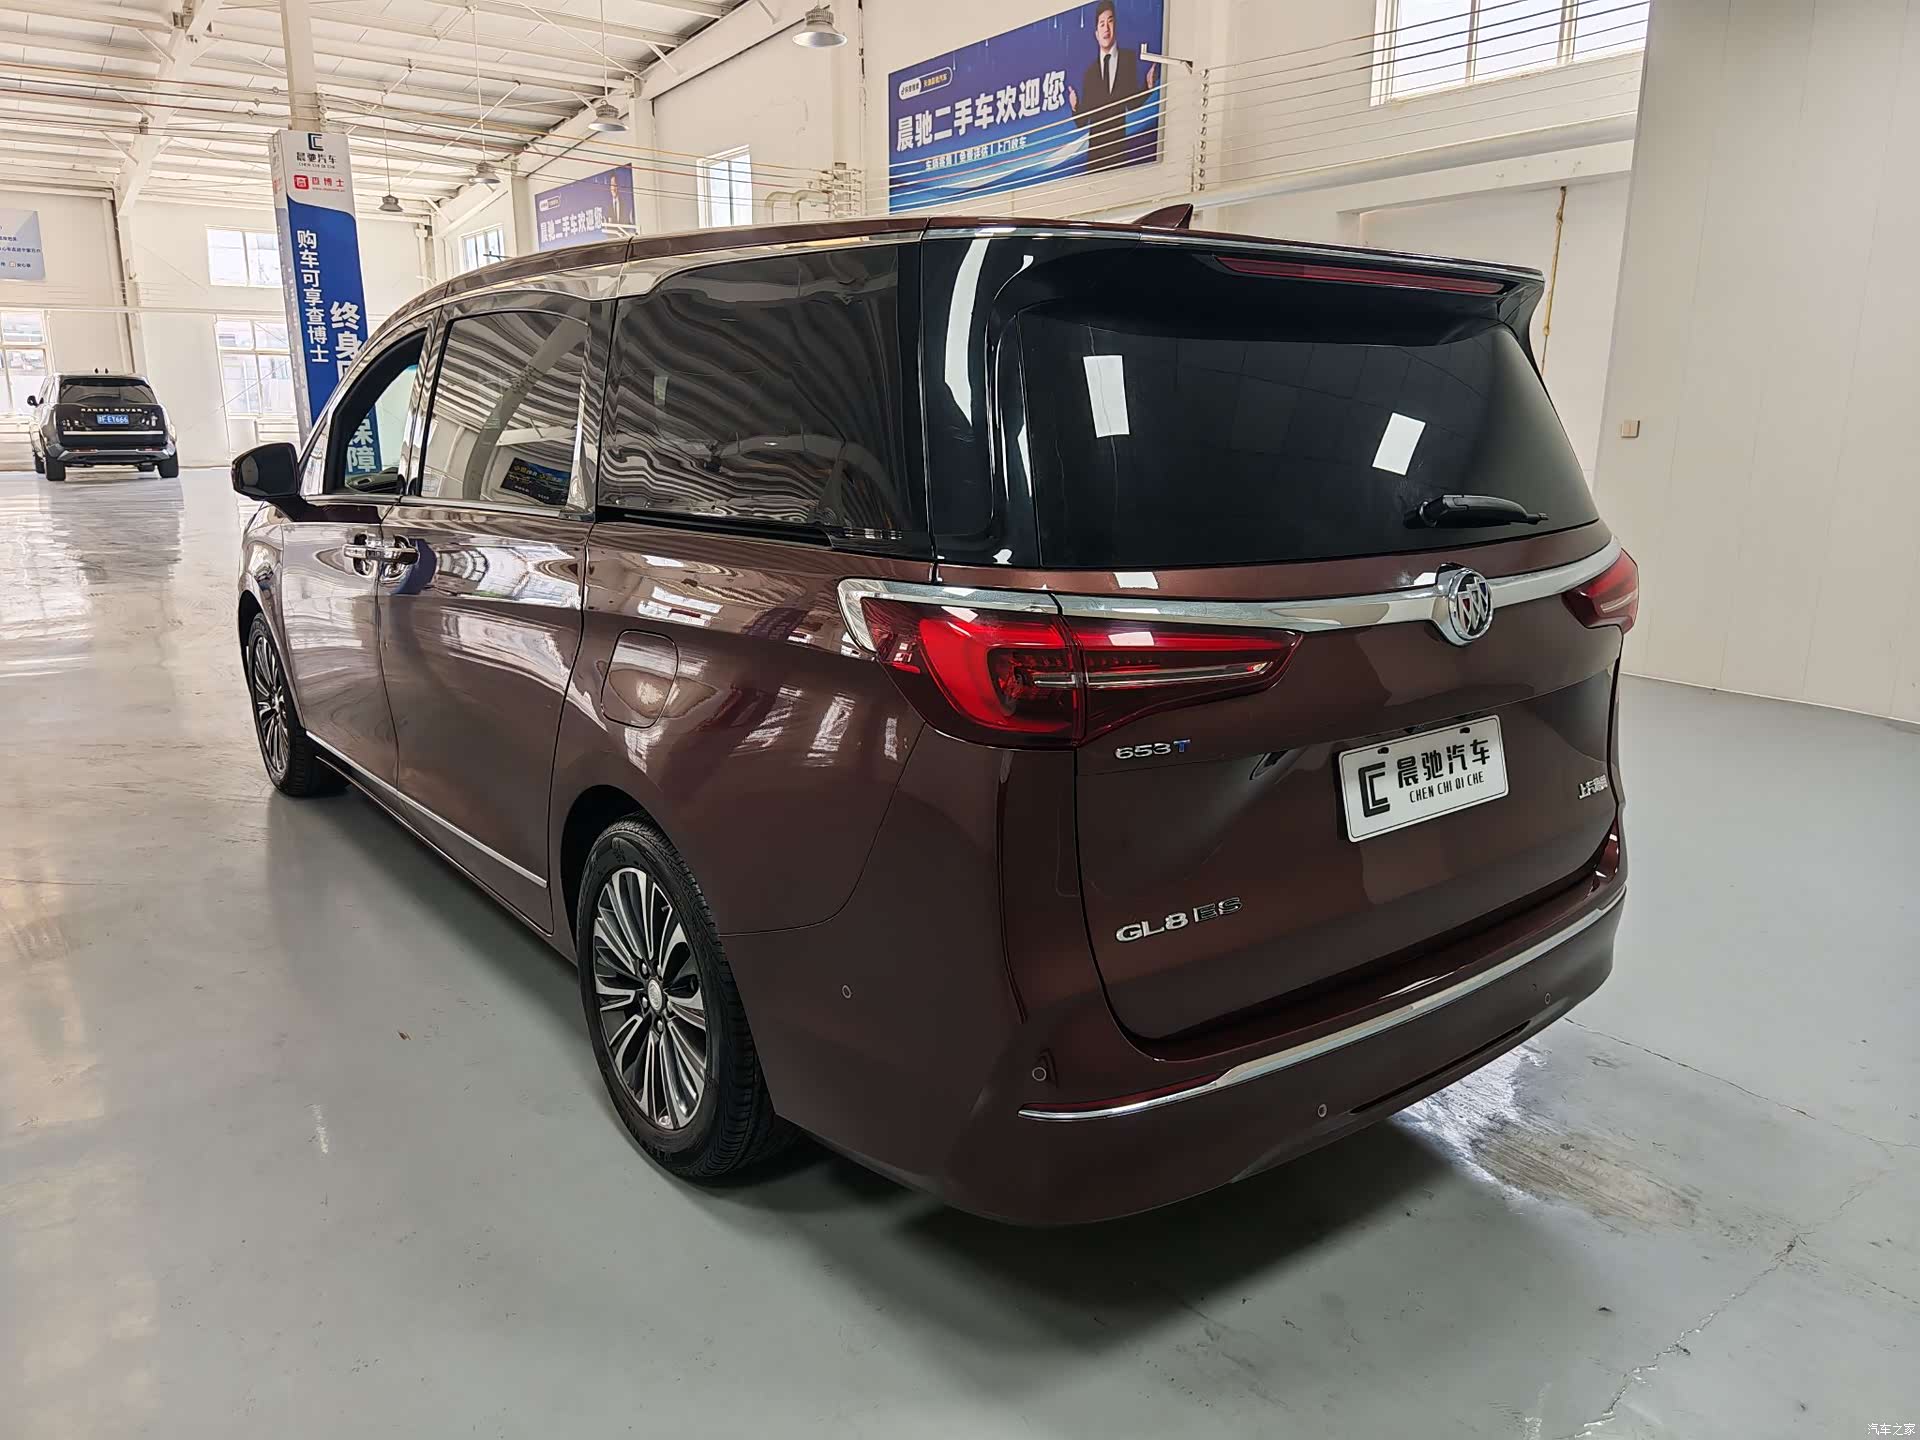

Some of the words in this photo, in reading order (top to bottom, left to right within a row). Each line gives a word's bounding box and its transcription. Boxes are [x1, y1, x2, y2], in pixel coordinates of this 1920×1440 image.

[897, 71, 1065, 152] 晨驰二手车欢迎您
[297, 230, 329, 362] 购车可享查博士
[1115, 738, 1191, 760] 653T
[1397, 739, 1491, 789] 晨驰汽车
[1409, 786, 1434, 803] CHEN
[1437, 780, 1453, 795] CHI
[1455, 777, 1465, 790] QI
[1467, 771, 1485, 787] CHE
[1115, 912, 1189, 942] GL8
[1193, 896, 1243, 923] ES
